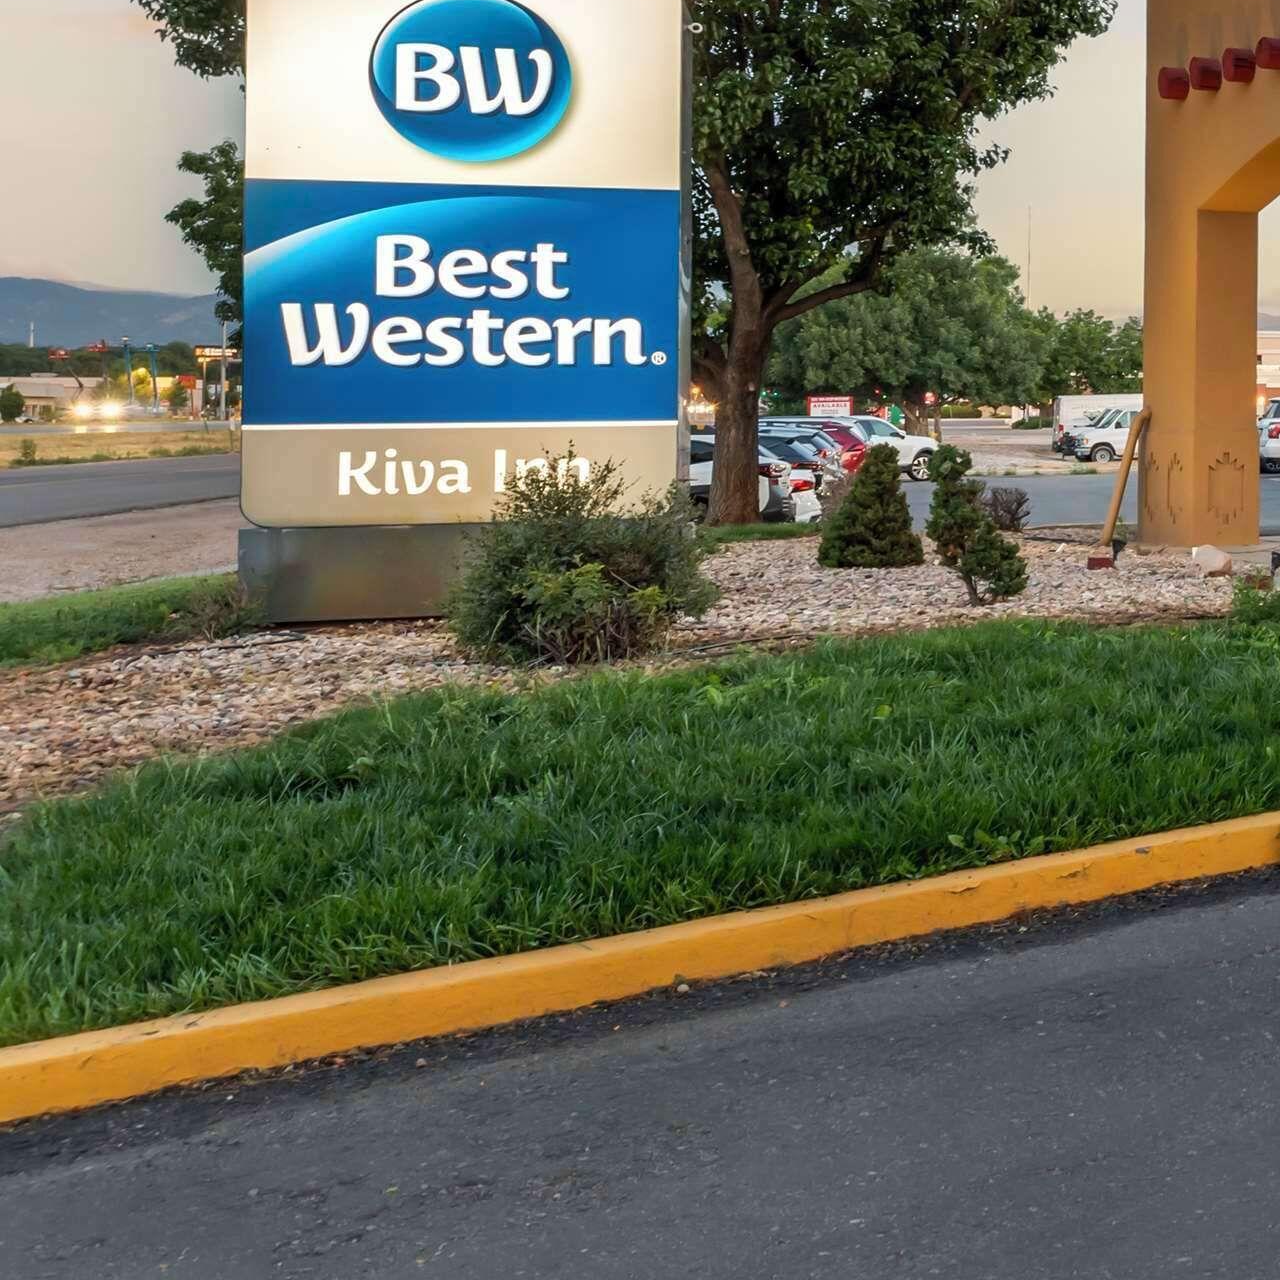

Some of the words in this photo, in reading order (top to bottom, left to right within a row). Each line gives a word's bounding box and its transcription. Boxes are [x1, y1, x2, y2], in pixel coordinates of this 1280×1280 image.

[394, 41, 554, 116] BW
[375, 234, 570, 299] Best
[336, 447, 472, 497] Kiva
